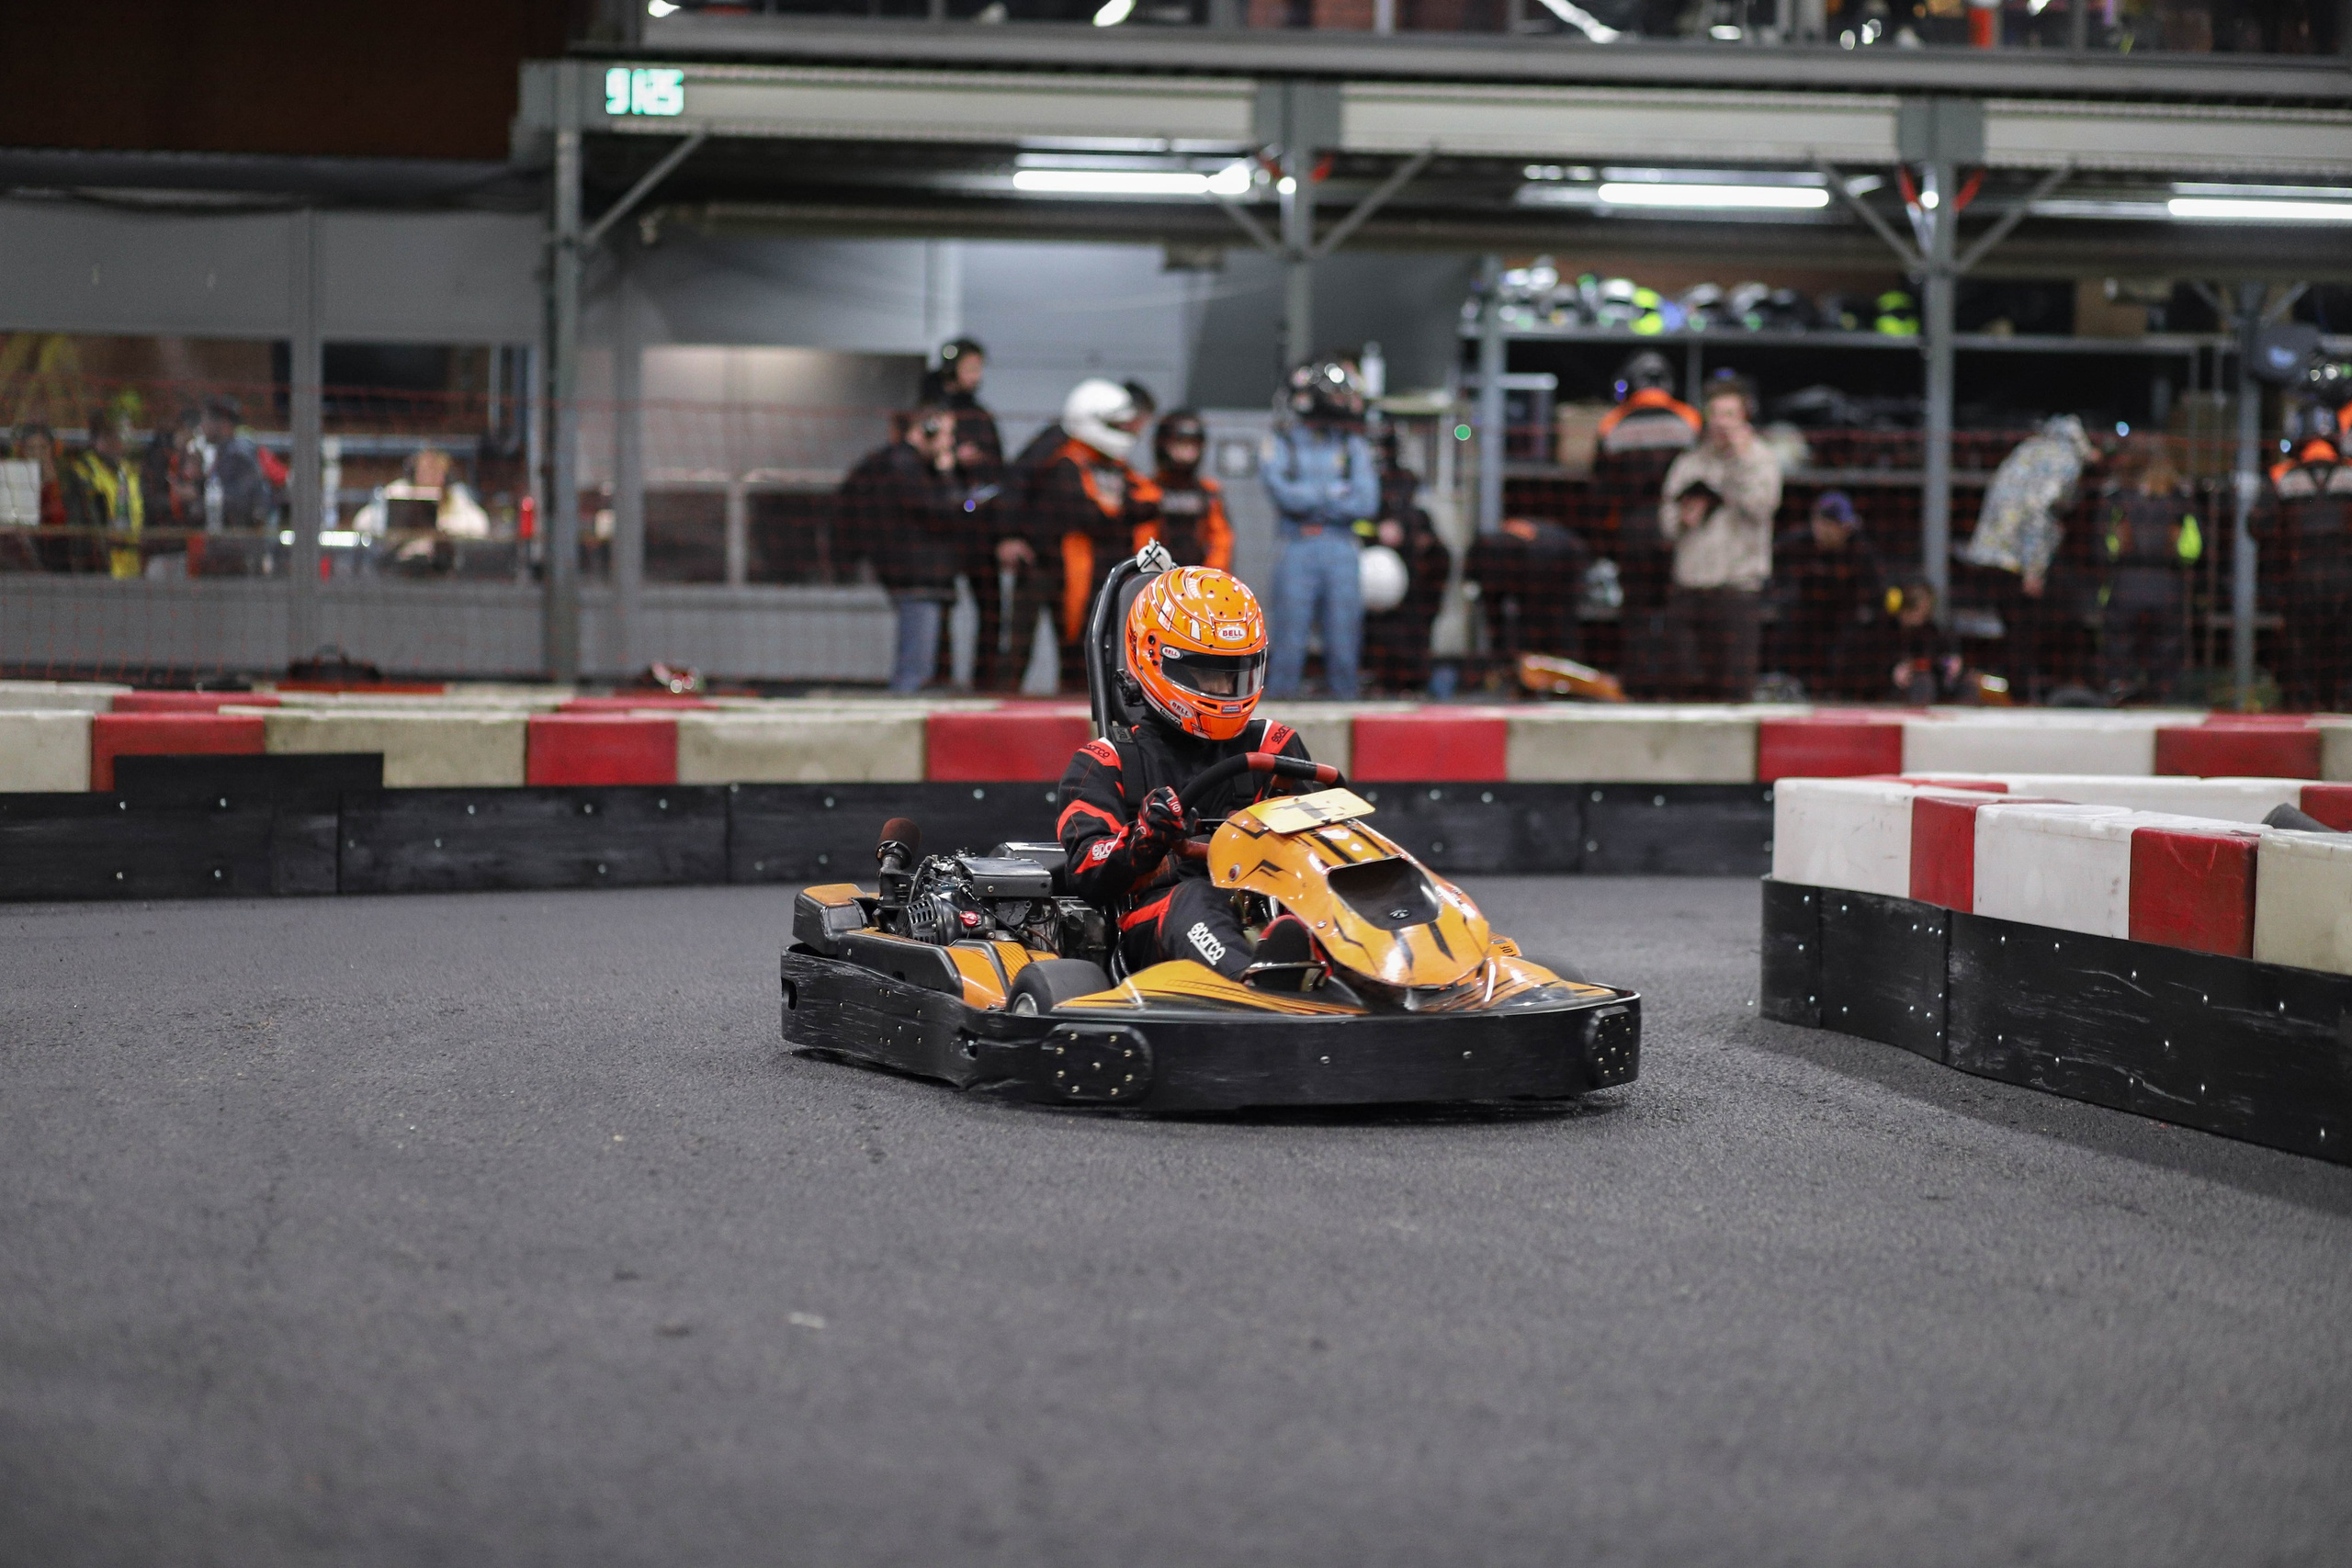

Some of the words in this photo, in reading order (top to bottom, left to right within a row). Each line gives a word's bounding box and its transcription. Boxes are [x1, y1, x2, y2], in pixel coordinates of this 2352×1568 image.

[1164, 649, 1178, 657] BELL
[1171, 702, 1189, 716] BELL
[1188, 922, 1226, 964] sparco
